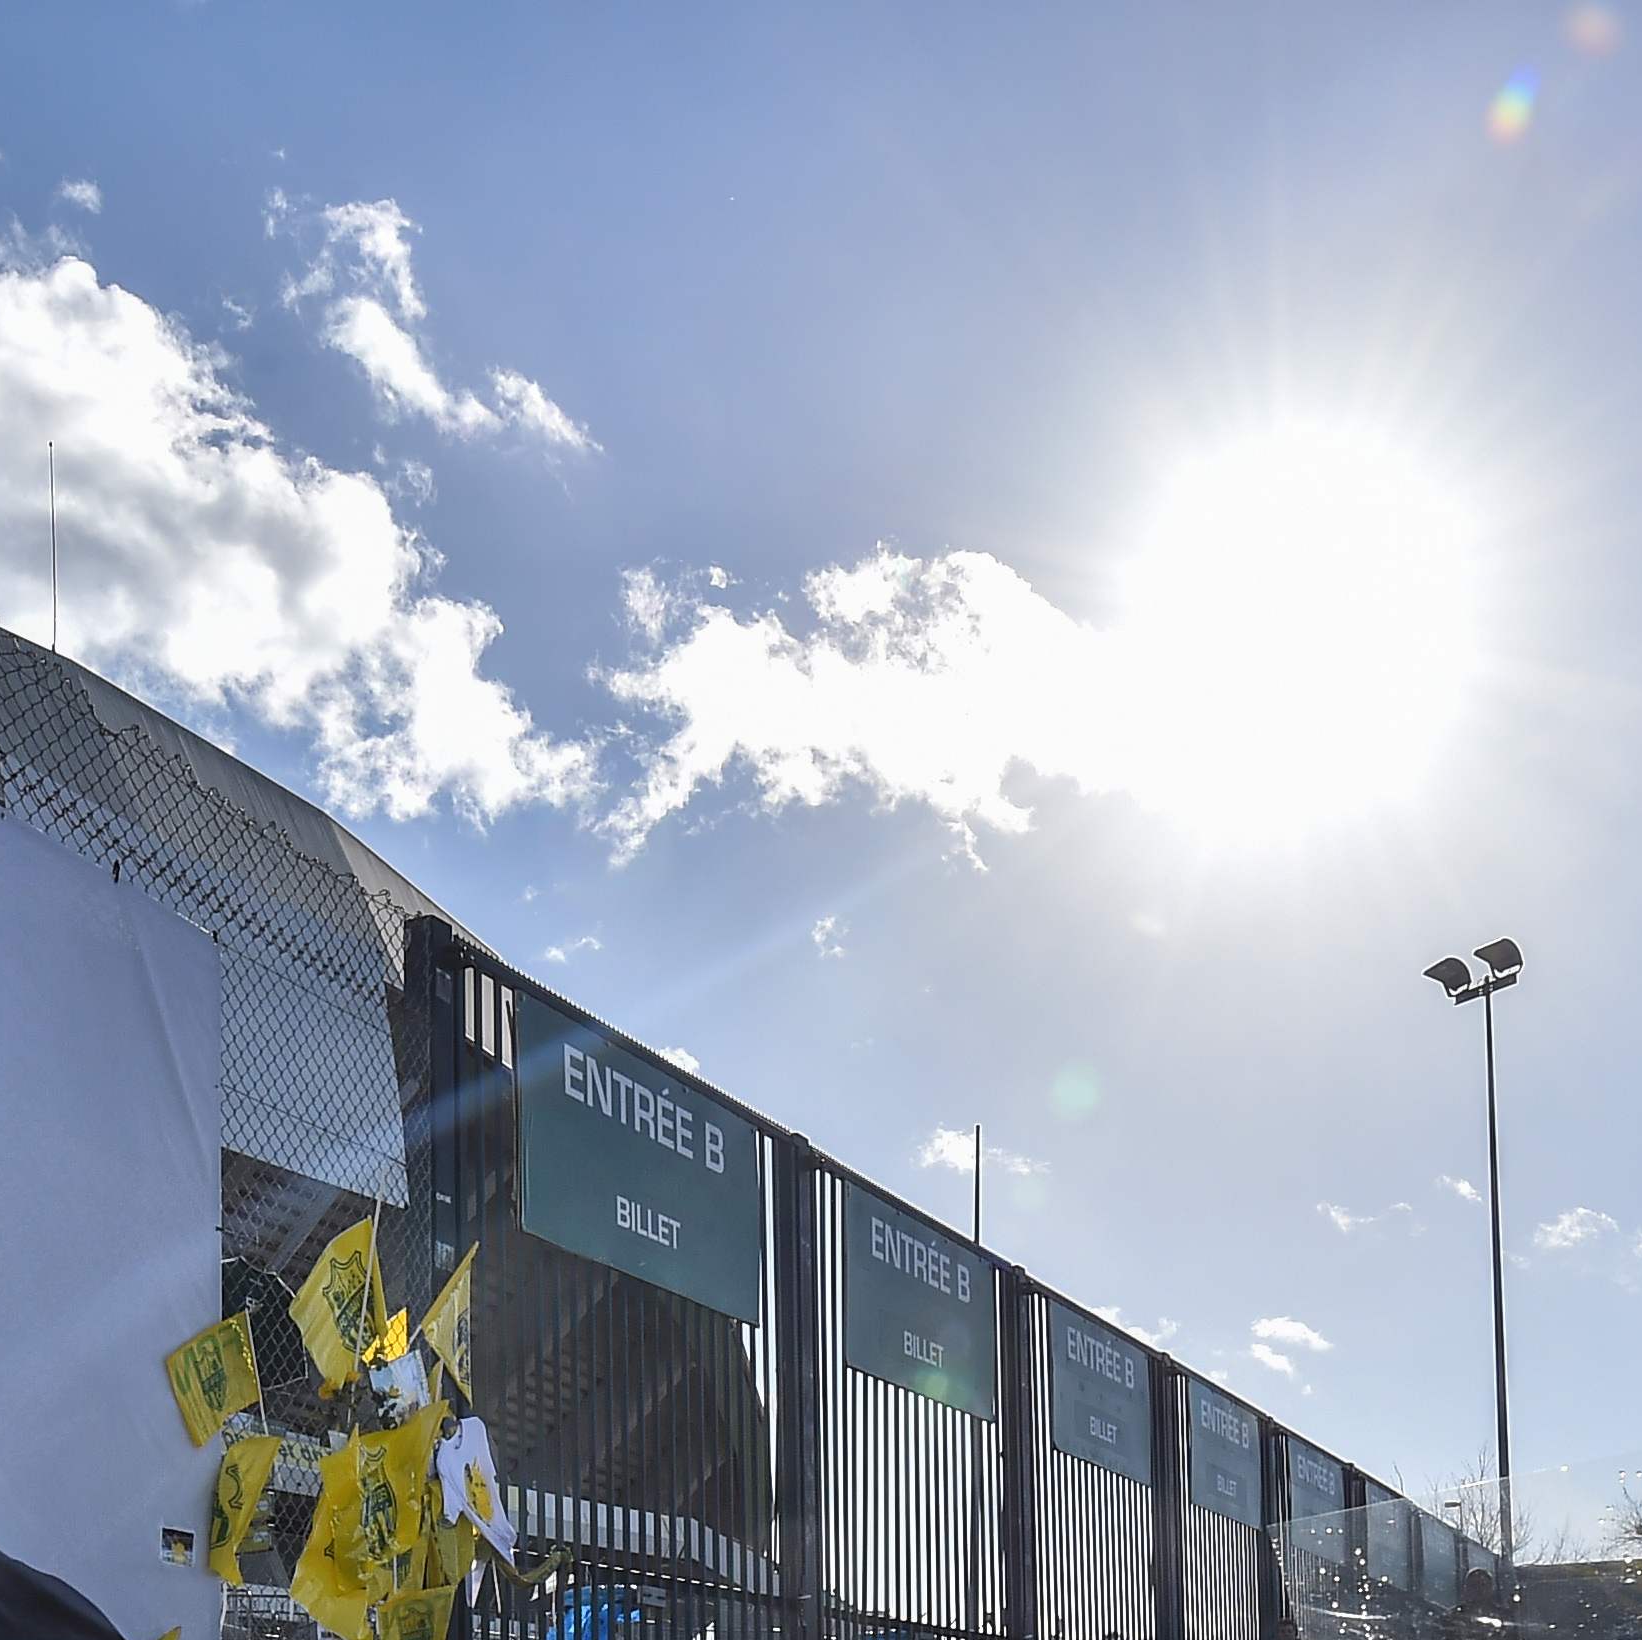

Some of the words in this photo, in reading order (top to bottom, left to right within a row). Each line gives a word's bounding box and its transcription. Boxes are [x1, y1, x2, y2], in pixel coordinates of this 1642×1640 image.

[564, 1043, 693, 1159] ENTRÉE
[705, 1122, 725, 1173] B
[617, 1195, 681, 1249] BILLET
[871, 1216, 951, 1294] ENTRÉE
[957, 1263, 971, 1303] B
[904, 1330, 944, 1368] BILLET
[1067, 1327, 1121, 1383] ENTRÉE
[1125, 1358, 1134, 1389] B
[1089, 1416, 1117, 1444] BILLET
[1200, 1399, 1240, 1445] ENTRÉE
[1242, 1423, 1249, 1448] B
[1217, 1474, 1237, 1496] BILLET
